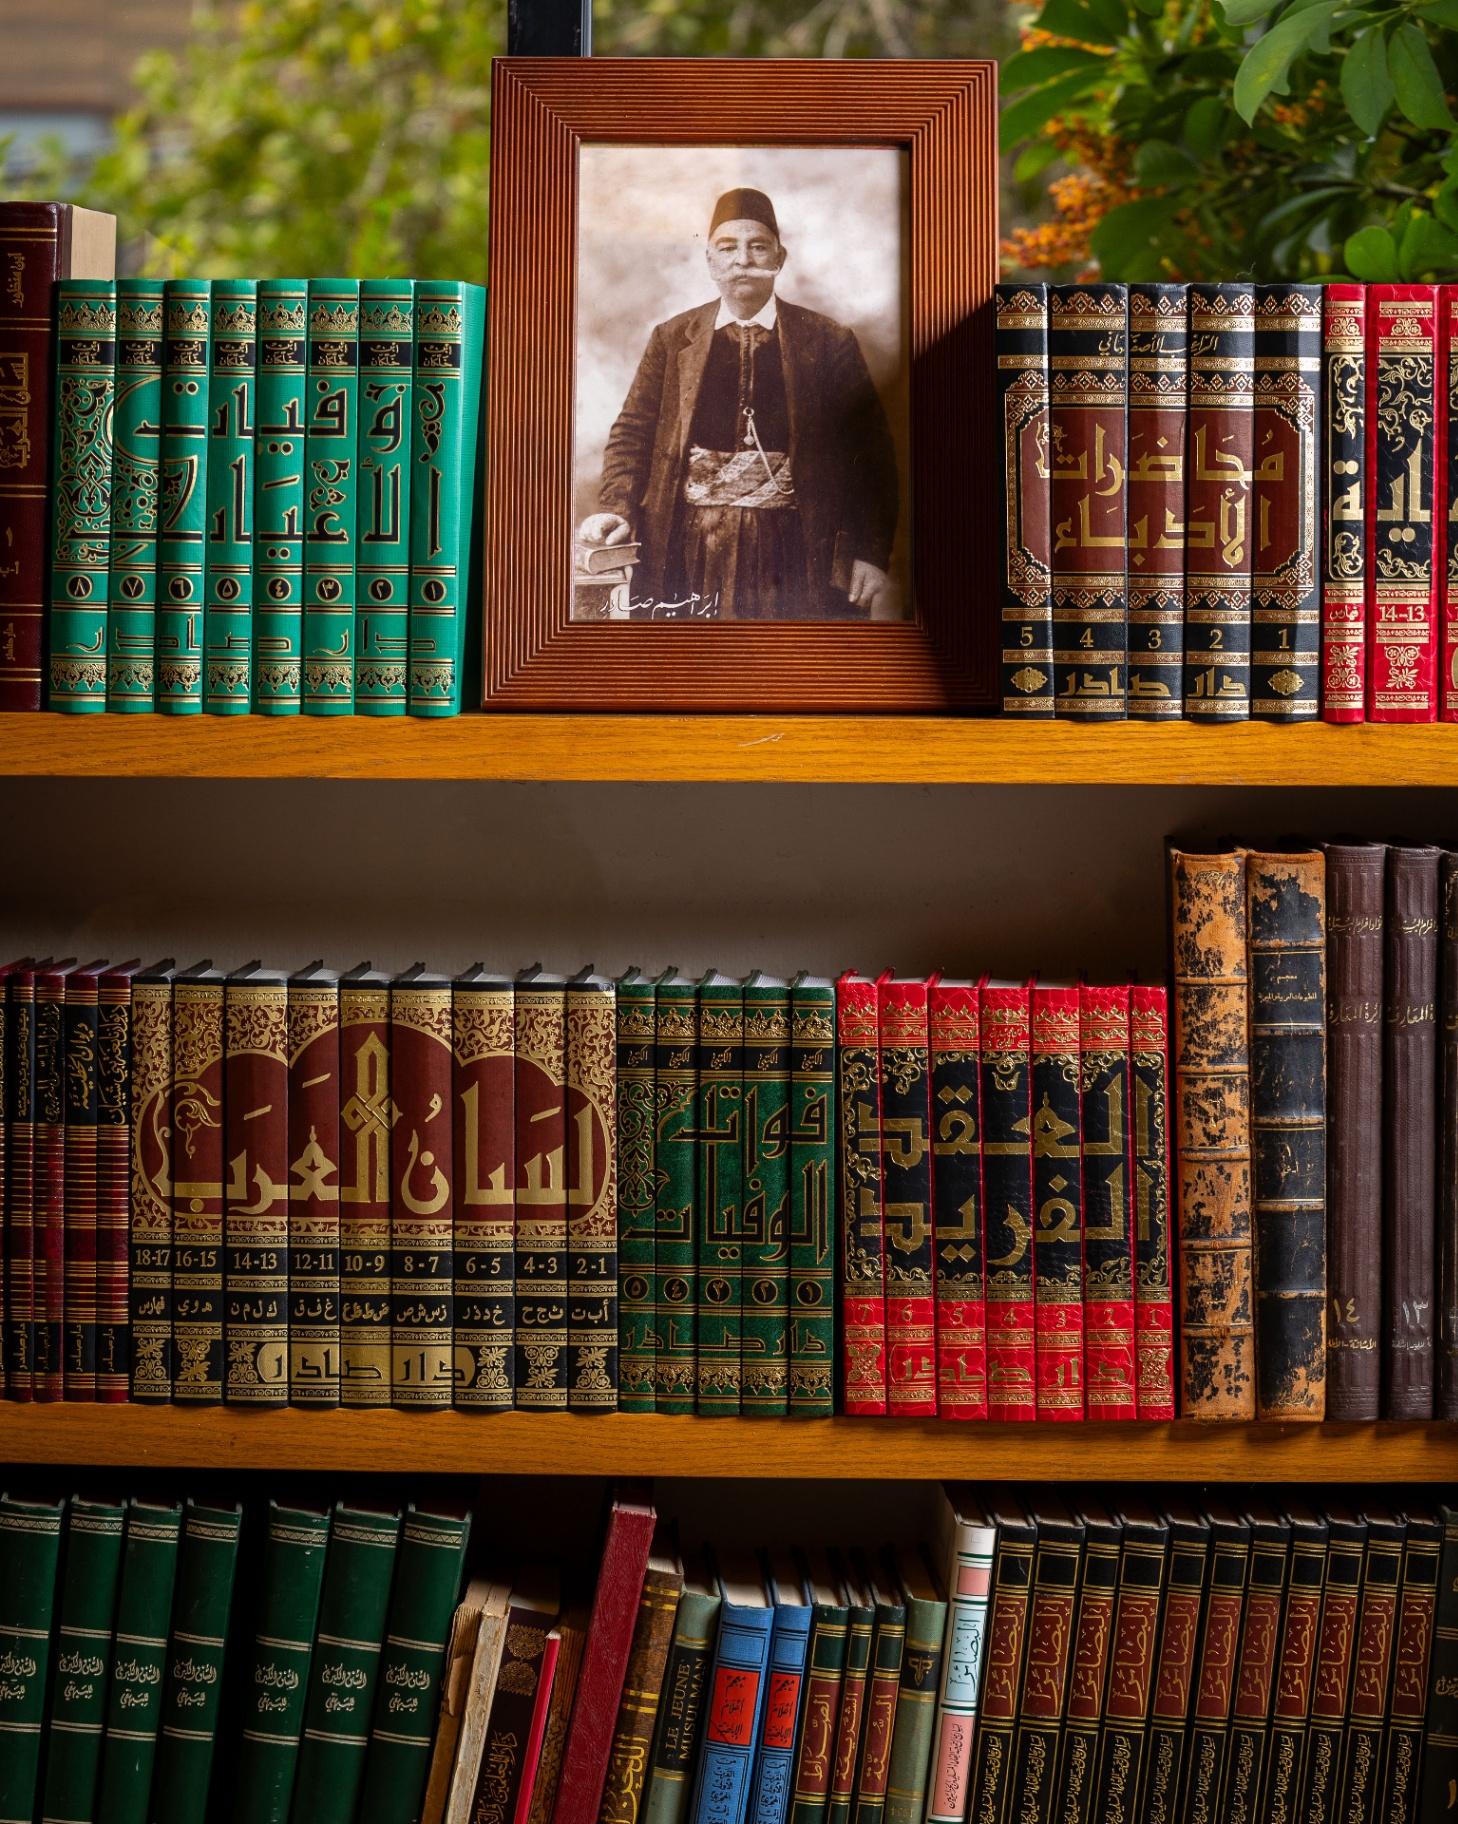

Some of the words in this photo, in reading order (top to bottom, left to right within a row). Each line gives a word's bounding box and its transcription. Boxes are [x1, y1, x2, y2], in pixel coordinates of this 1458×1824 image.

[1379, 605, 1425, 622] 14-13
[1020, 627, 1034, 647] 5
[1079, 628, 1094, 649] 4
[1148, 628, 1162, 649] 3
[1209, 629, 1223, 649] 2
[1278, 629, 1290, 649] 1
[135, 1249, 170, 1266] 18-17
[174, 1250, 217, 1268] 16-15
[233, 1252, 278, 1270] 14-13
[294, 1253, 335, 1270] 12-11
[858, 1304, 871, 1322] 7
[902, 1304, 913, 1322] 6
[953, 1307, 964, 1325] 5
[1004, 1308, 1018, 1325] 4
[1056, 1311, 1066, 1328] 3
[1104, 1308, 1115, 1326] 2
[1150, 1309, 1157, 1326] 1
[1333, 1297, 1360, 1324] ١٤
[679, 1657, 705, 1760] MUSULMAN
